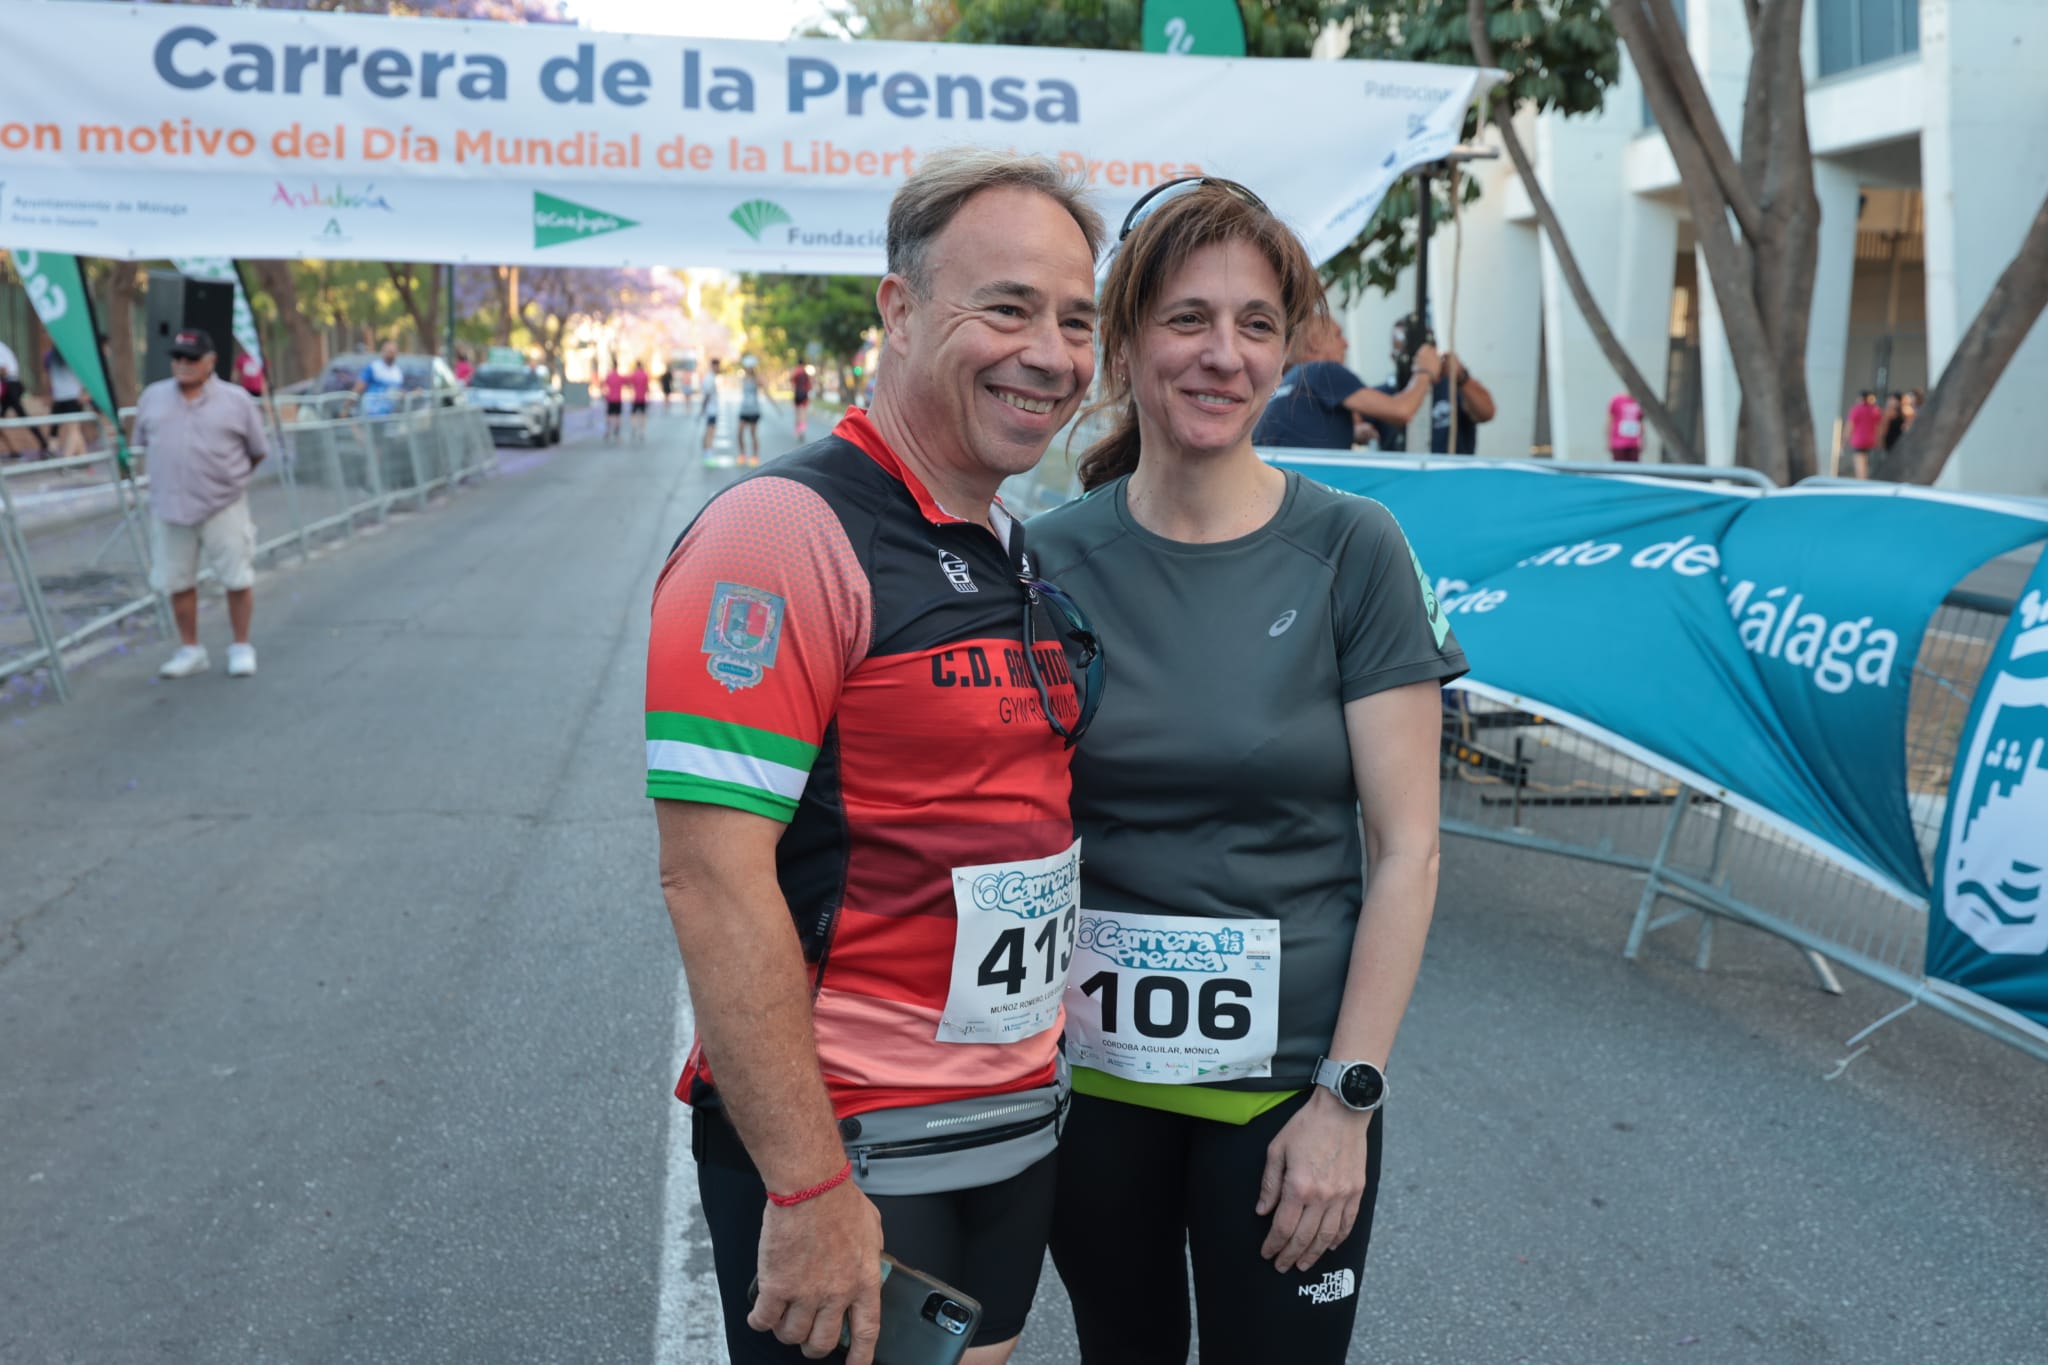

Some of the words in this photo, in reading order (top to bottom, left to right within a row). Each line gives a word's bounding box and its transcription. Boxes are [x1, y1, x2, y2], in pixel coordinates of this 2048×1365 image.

[153, 25, 509, 102] Carrera
[540, 44, 652, 106] de
[682, 49, 756, 114] la
[787, 55, 1081, 125] Prensa
[0, 121, 62, 152] on
[78, 118, 257, 158] motivo
[271, 122, 345, 160] del
[363, 124, 439, 164] Día
[455, 130, 640, 169] Mundial
[656, 135, 713, 172] de
[728, 137, 767, 173] la
[783, 140, 928, 179] Libert
[787, 227, 889, 247] Fundació
[1630, 535, 1720, 577] de
[931, 646, 1003, 688] C.D.
[977, 904, 1076, 996] 413
[1096, 925, 1217, 952] Carrera
[1115, 950, 1225, 972] Prensa
[1080, 970, 1253, 1041] 106
[1298, 1279, 1342, 1297] NORTH
[1322, 1269, 1344, 1283] THE
[1312, 1290, 1341, 1305] FACE
